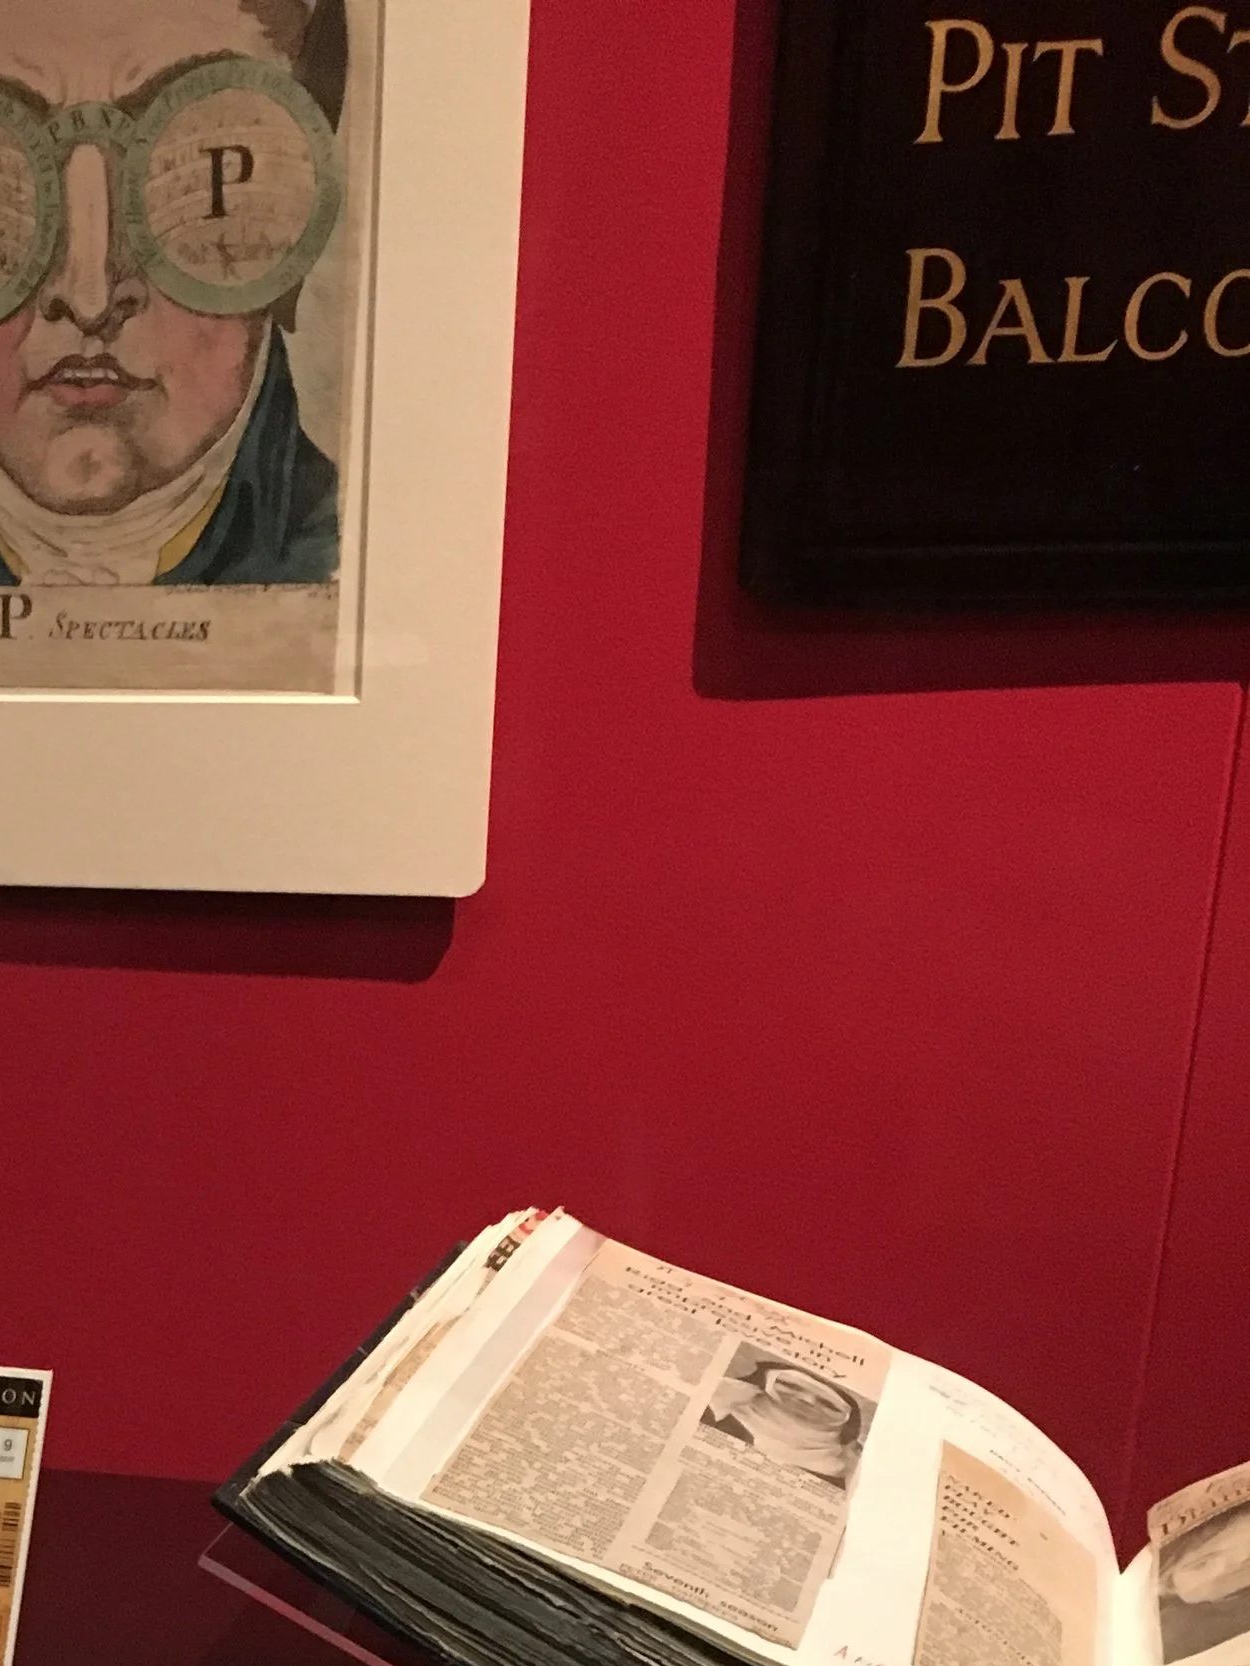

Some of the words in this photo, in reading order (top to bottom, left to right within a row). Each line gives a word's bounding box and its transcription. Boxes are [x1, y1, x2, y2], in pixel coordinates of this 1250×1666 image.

[913, 19, 1104, 144] PIT
[198, 144, 255, 219] P
[3, 1438, 13, 1452] 9
